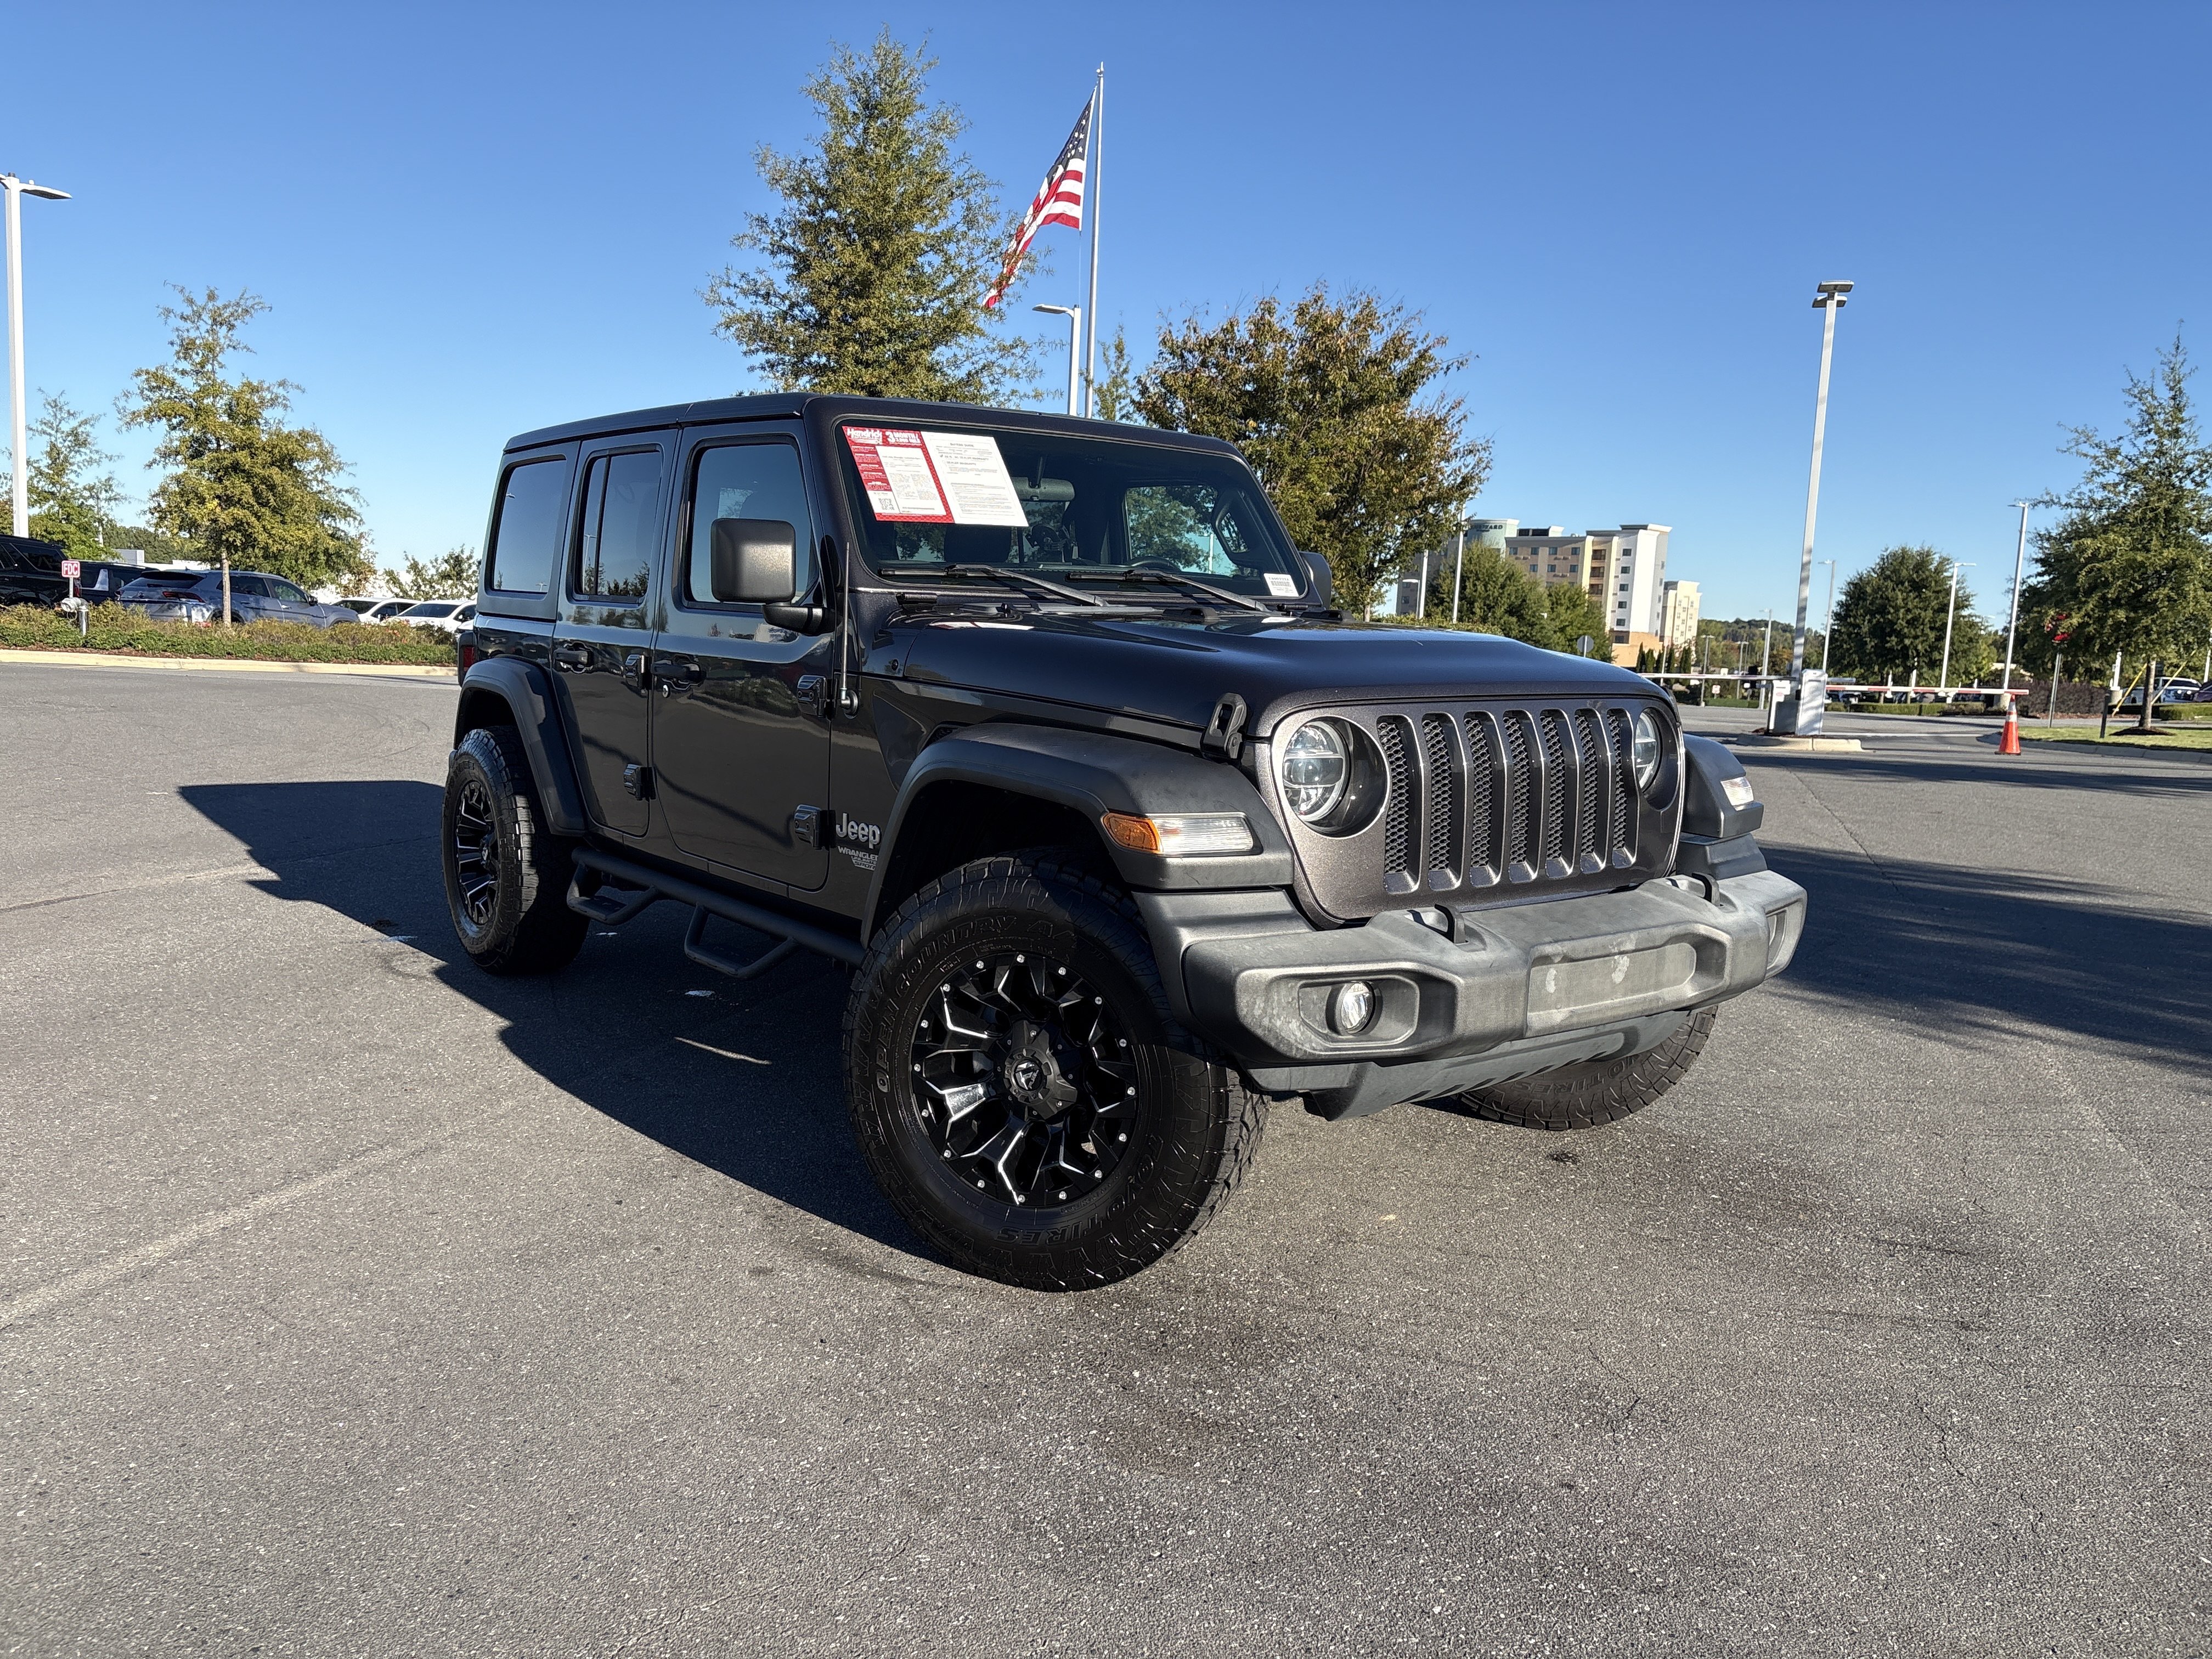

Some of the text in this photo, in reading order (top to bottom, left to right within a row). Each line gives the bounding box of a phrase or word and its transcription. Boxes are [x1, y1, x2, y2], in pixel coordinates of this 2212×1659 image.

[885, 431, 896, 443] 3
[64, 563, 78, 575] FDC
[836, 812, 882, 849] Jeep
[851, 855, 877, 865] UNLIMITE
[854, 861, 876, 870] SPOR
[874, 997, 900, 1093] OPEN
[895, 915, 1018, 997] COUNTRY
[994, 1213, 1103, 1247] TIRES
